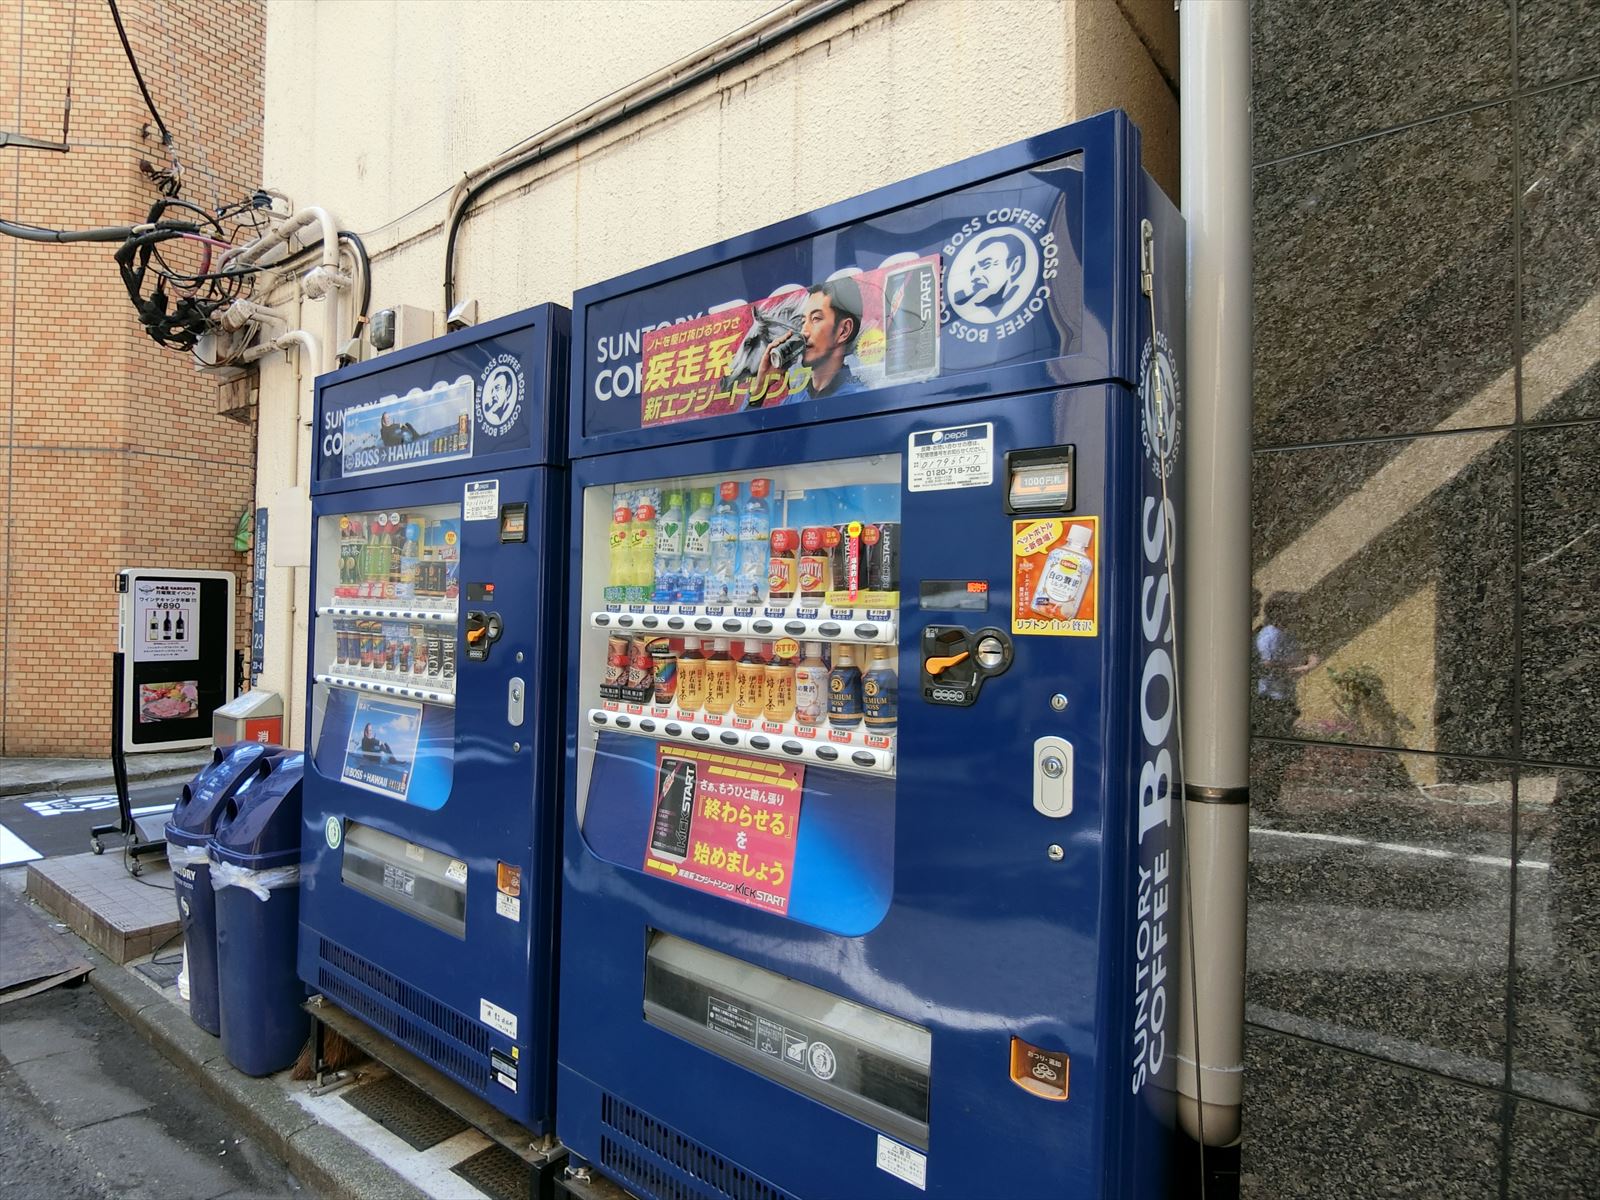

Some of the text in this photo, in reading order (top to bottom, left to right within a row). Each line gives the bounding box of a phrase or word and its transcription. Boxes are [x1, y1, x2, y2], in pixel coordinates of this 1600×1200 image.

[943, 207, 1059, 343] BOSS COFFEE BOSS COFFEE BOSS
[481, 357, 497, 381] BOSS
[498, 353, 521, 373] COFFEE
[517, 372, 525, 401] BOSS
[643, 331, 744, 393] 疾走系
[642, 367, 814, 421] 新エナジードリンク
[944, 429, 968, 443] pepsi
[353, 439, 429, 468] BOSS HAWAII
[926, 465, 981, 477] 0120-718-700
[254, 633, 264, 649] 23
[1017, 620, 1048, 630] リプトン
[428, 641, 439, 675] BLACK
[443, 643, 454, 677] BLACK
[1138, 495, 1176, 845] BOSS
[348, 767, 388, 787] BOSS HAWAII
[677, 765, 695, 849] KICKSTART
[735, 831, 748, 850] を
[693, 841, 786, 886] 始めましょう
[735, 882, 787, 907] KICKSTART
[1132, 864, 1151, 1095] SUNTORY
[1149, 849, 1171, 1077] COFFEE
